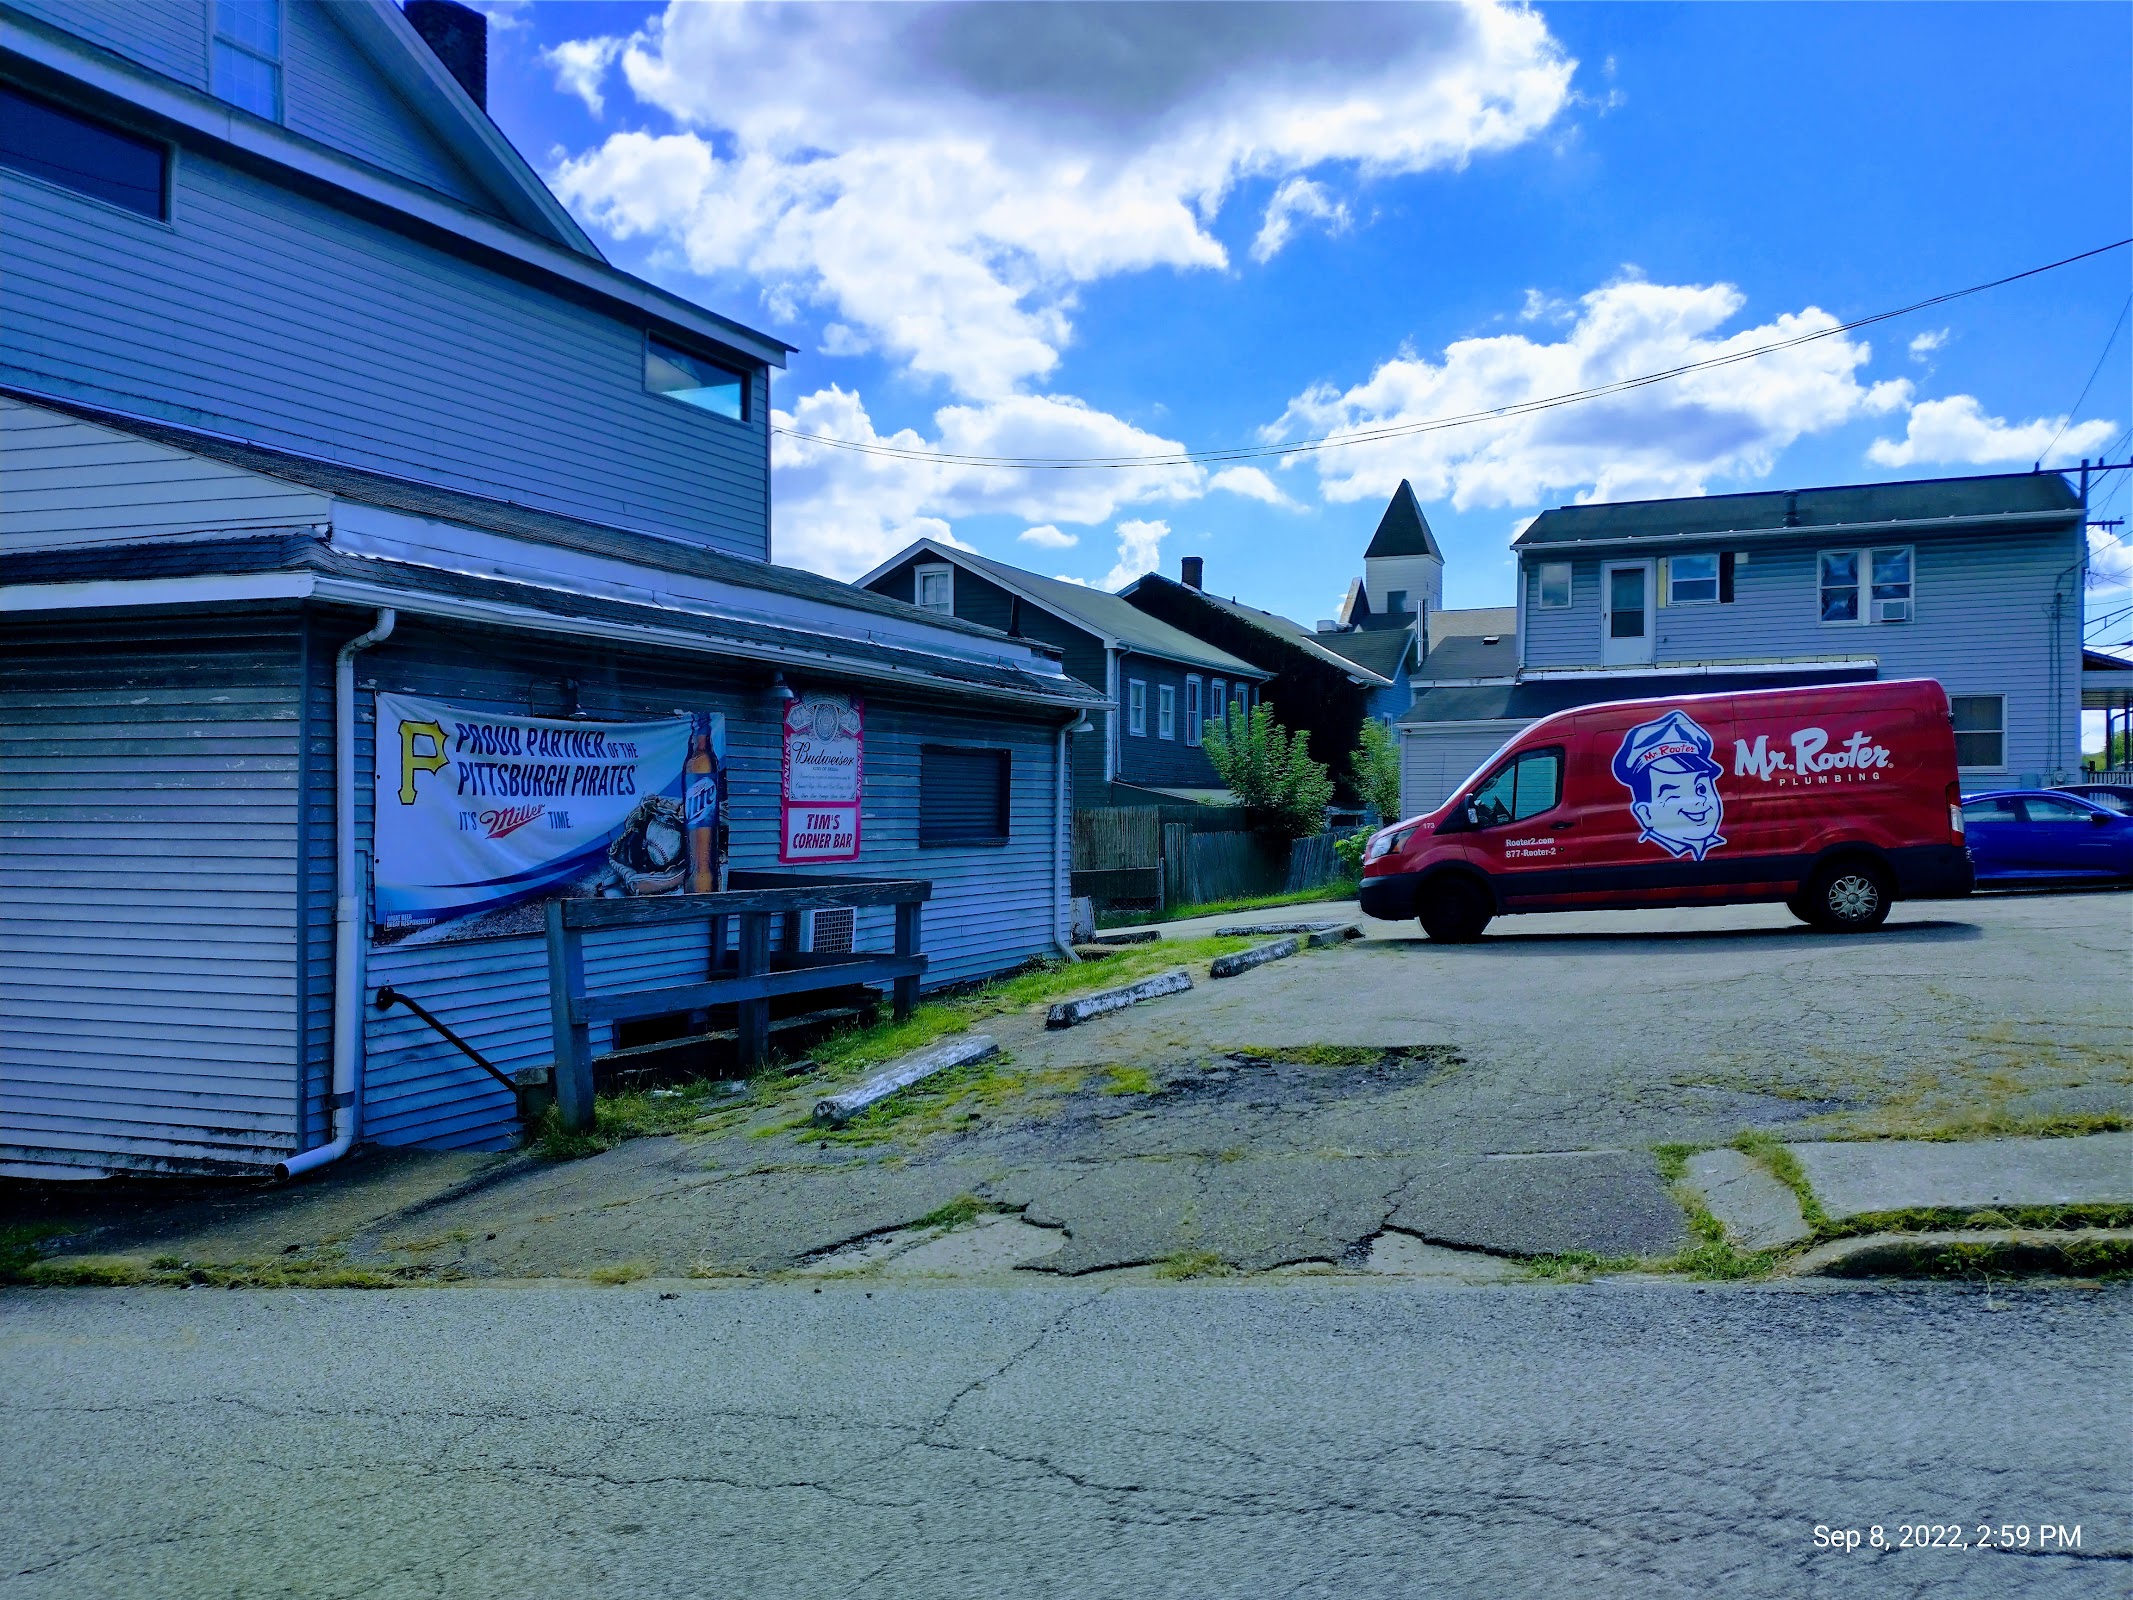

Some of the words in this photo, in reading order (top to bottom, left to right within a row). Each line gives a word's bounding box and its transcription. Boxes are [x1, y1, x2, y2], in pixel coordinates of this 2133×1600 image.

[455, 723, 521, 757] PROUD
[526, 727, 607, 759] PARTNER
[608, 742, 618, 758] OF
[620, 742, 639, 759] THE
[1659, 744, 1696, 755] Rooter
[791, 741, 855, 766] Budweiser
[1733, 735, 1795, 782] Mr.
[457, 762, 567, 797] PITTSBURGH
[571, 763, 636, 796] PIRATES
[1779, 772, 1880, 787] PLUMBING
[687, 783, 716, 821] Lite
[459, 811, 477, 831] IT'S
[480, 803, 546, 838] Miller
[547, 811, 574, 830] TIME.
[806, 814, 841, 830] TIM'S
[793, 833, 831, 849] CORNER
[834, 833, 853, 849] BAR
[1505, 837, 1555, 847] Rooter2.com
[1505, 847, 1556, 858] 877-Rooter-2
